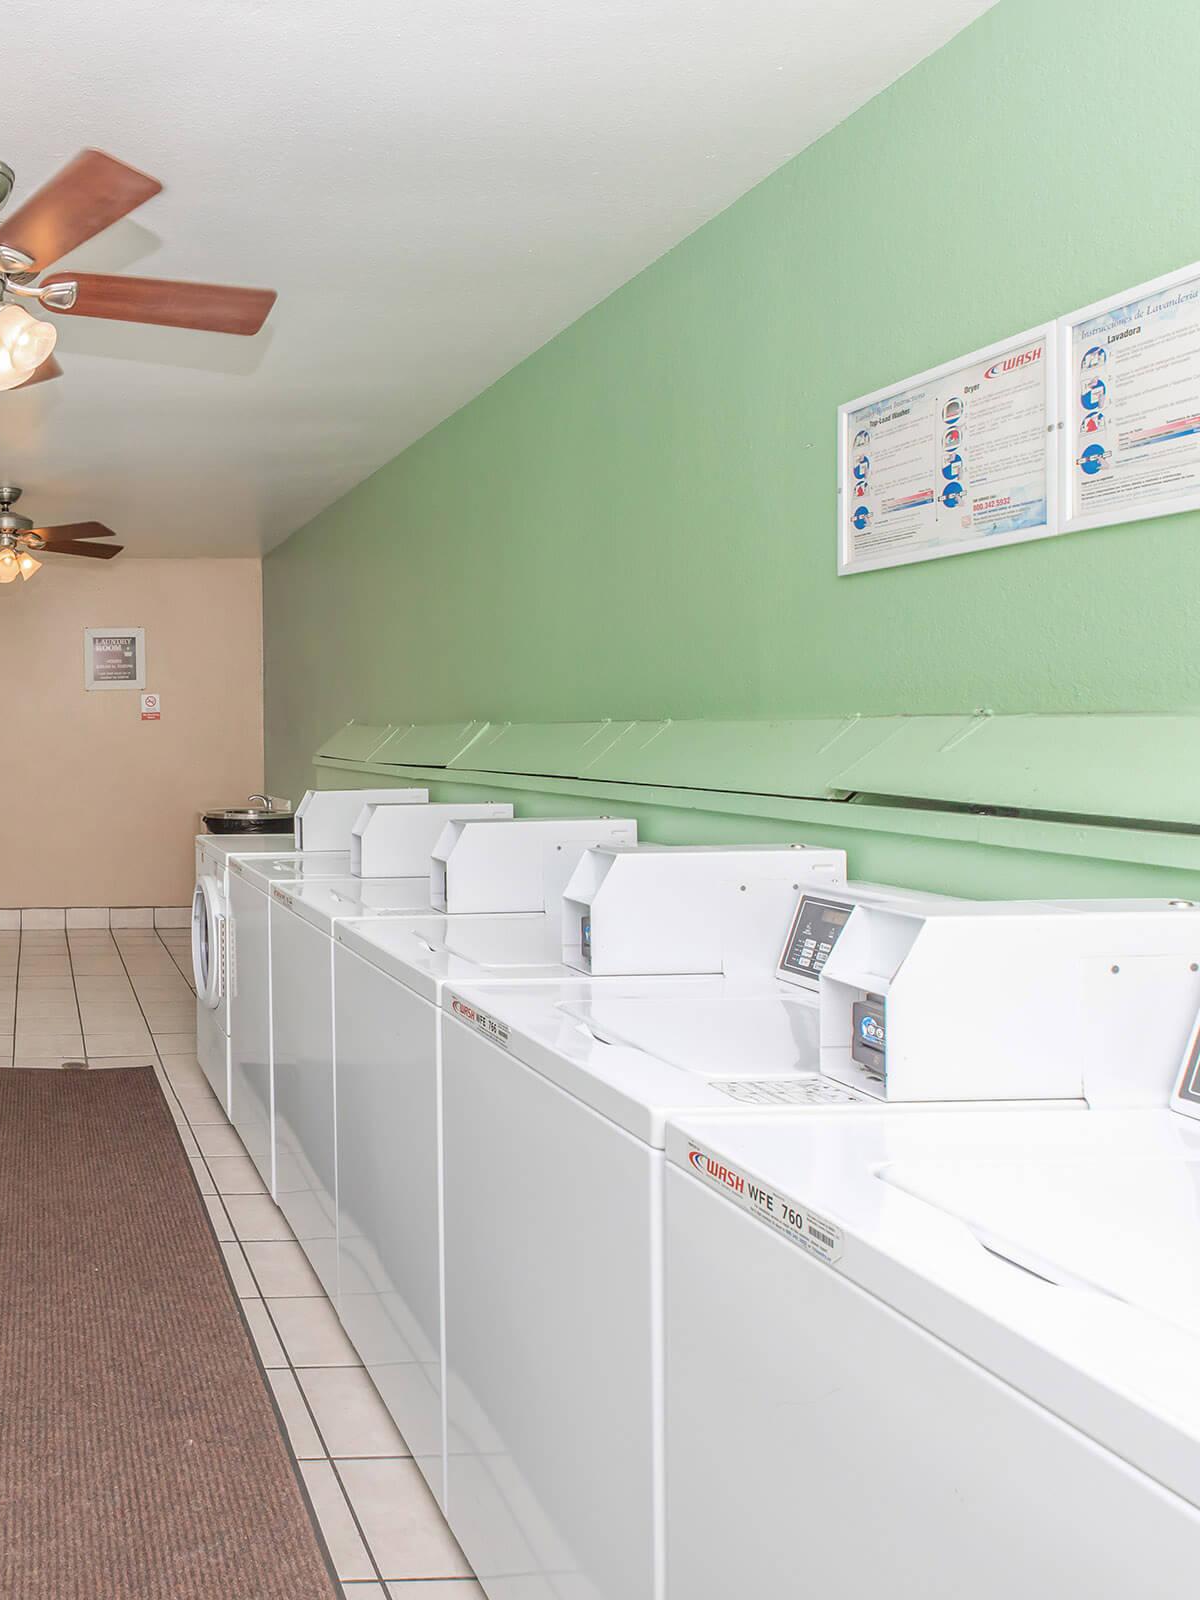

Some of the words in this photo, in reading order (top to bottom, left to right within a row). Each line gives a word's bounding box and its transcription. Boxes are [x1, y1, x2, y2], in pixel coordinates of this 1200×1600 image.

[1081, 316, 1133, 340] Instrucciones
[1134, 308, 1145, 321] de
[1107, 325, 1141, 344] Lavadora
[1001, 347, 1042, 372] WASH
[964, 383, 981, 394] Dryer
[706, 1158, 745, 1194] WASH
[748, 1183, 774, 1212] WFE
[781, 1203, 803, 1230] 760
